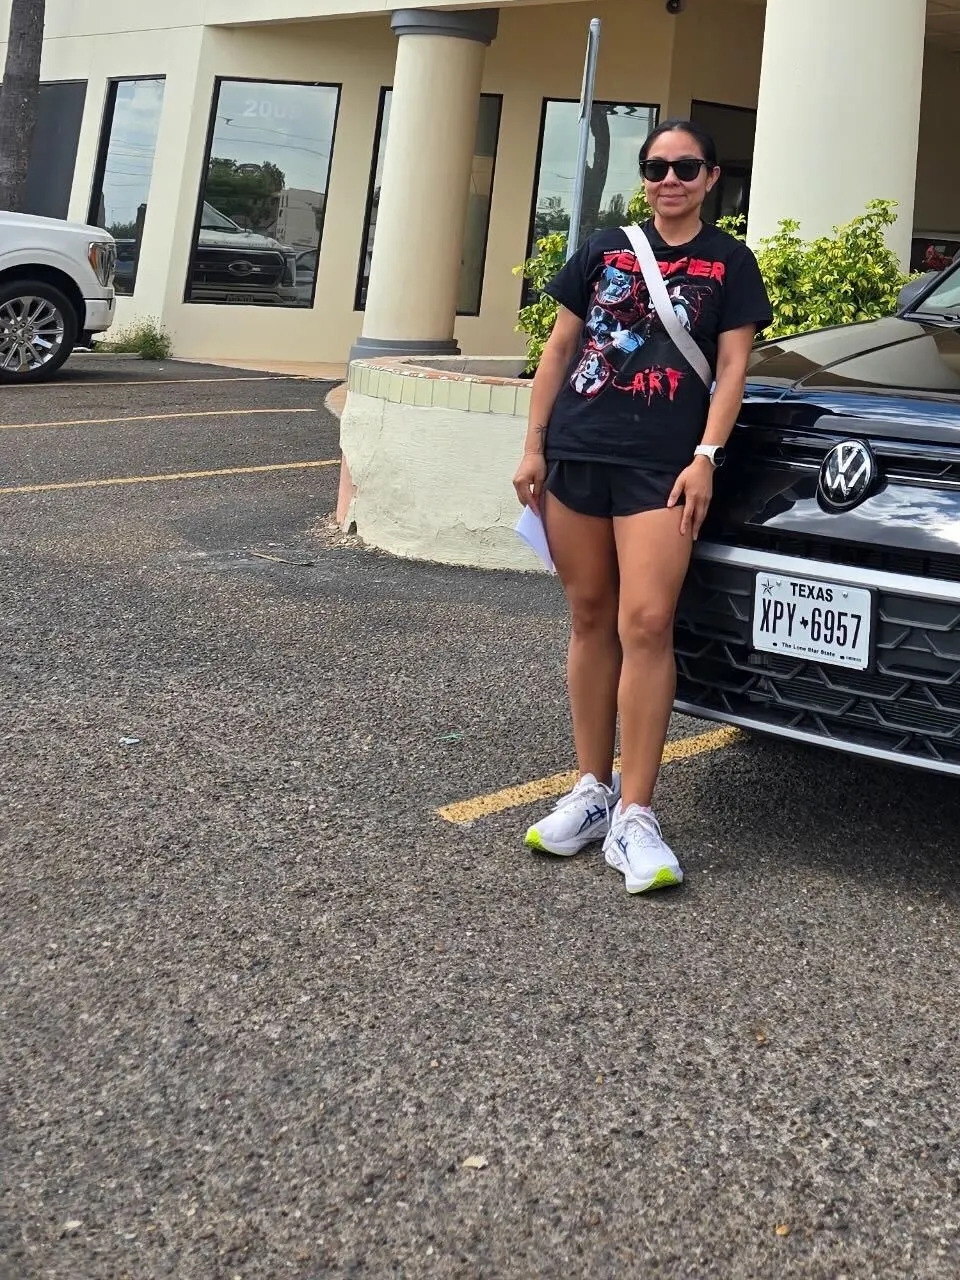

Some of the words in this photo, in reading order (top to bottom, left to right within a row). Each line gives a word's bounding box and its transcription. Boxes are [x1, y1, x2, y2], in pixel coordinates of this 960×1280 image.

[631, 367, 685, 405] ART
[790, 582, 833, 602] TEXAS
[793, 644, 807, 652] Lone
[820, 649, 836, 657] State
